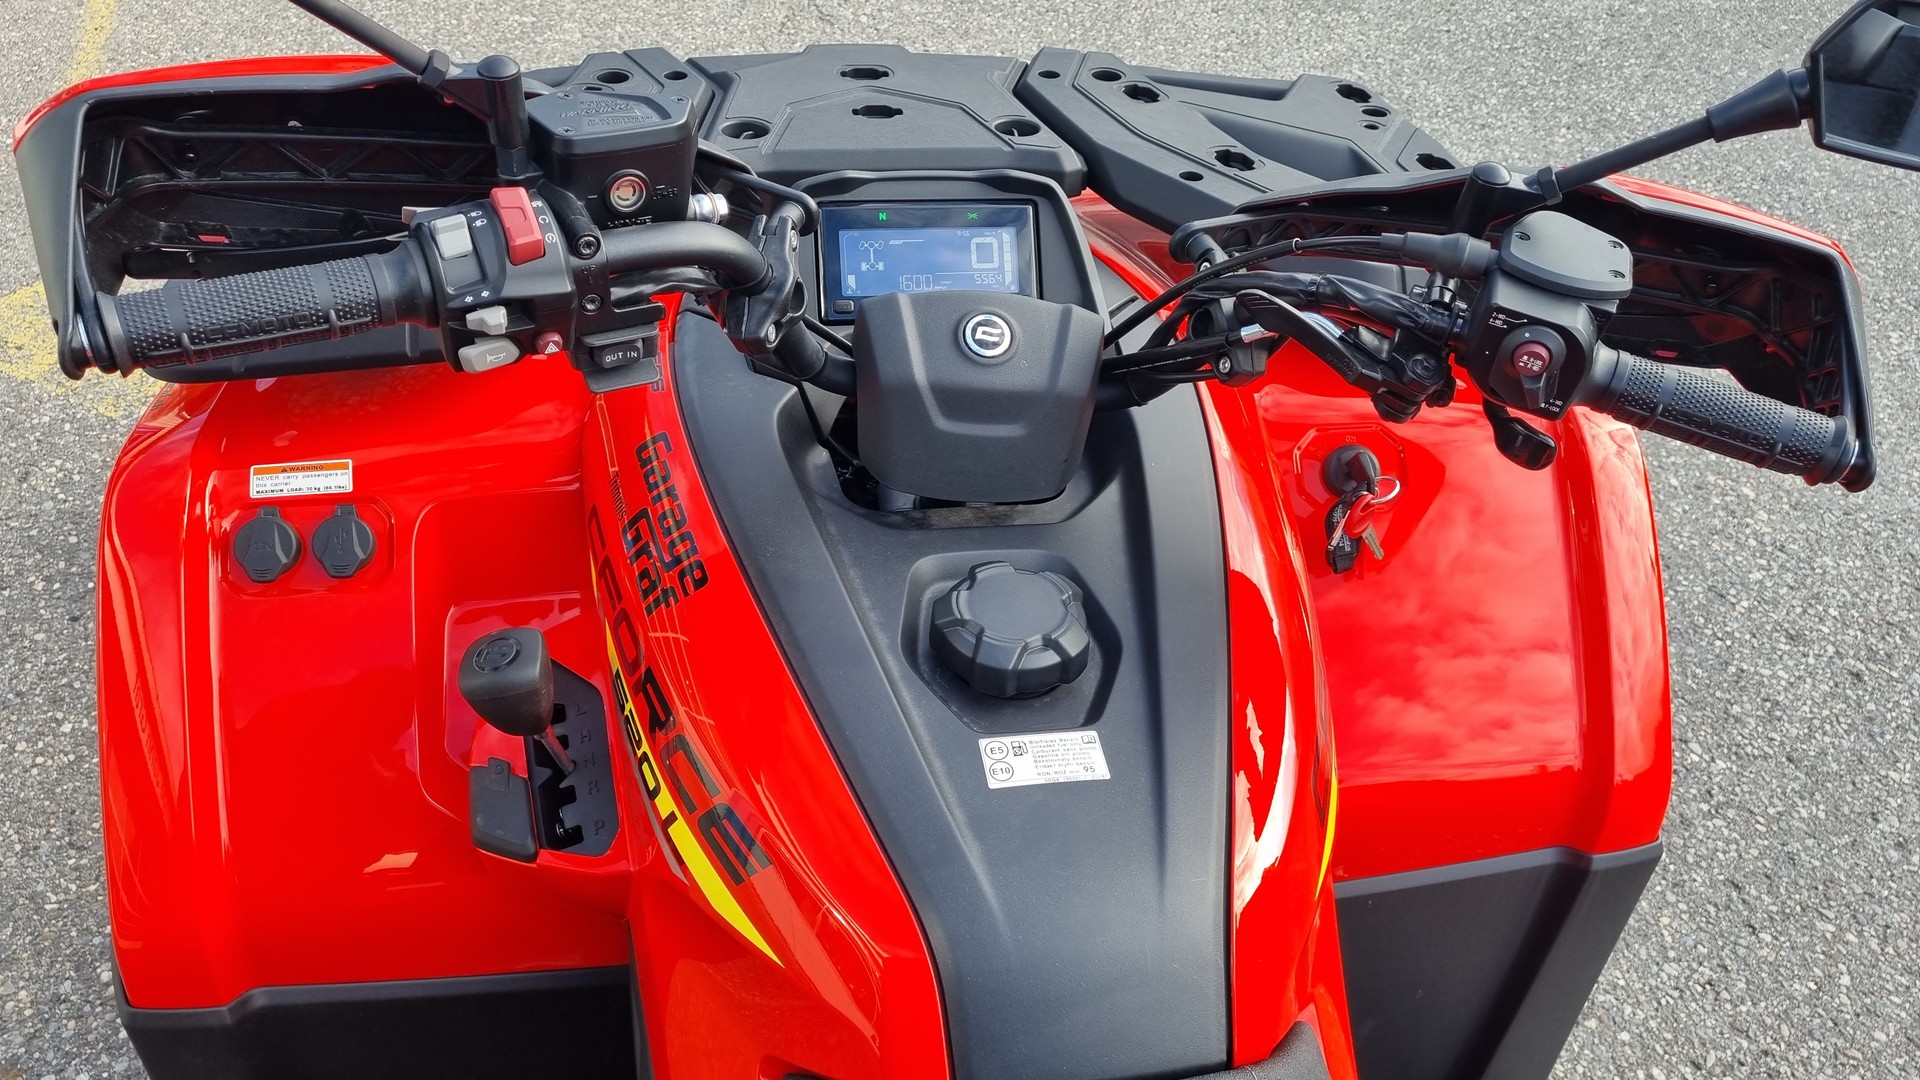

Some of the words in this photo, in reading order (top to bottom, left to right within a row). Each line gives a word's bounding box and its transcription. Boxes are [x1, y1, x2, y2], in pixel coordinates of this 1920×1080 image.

[879, 213, 887, 221] N
[899, 274, 933, 291] 1600
[974, 273, 1002, 284] 5564
[204, 311, 313, 340] CFMOTO
[605, 351, 623, 362] OUT
[627, 350, 638, 358] IN
[1345, 435, 1357, 443] ON
[288, 464, 324, 472] WARNING
[635, 431, 709, 598] Garage
[621, 507, 680, 618] Graf
[587, 503, 772, 887] CFORCE
[990, 746, 1004, 755] E5
[613, 668, 661, 803] 520
[660, 810, 685, 868] L
[992, 767, 1011, 776] E10
[1083, 765, 1096, 773] 95
